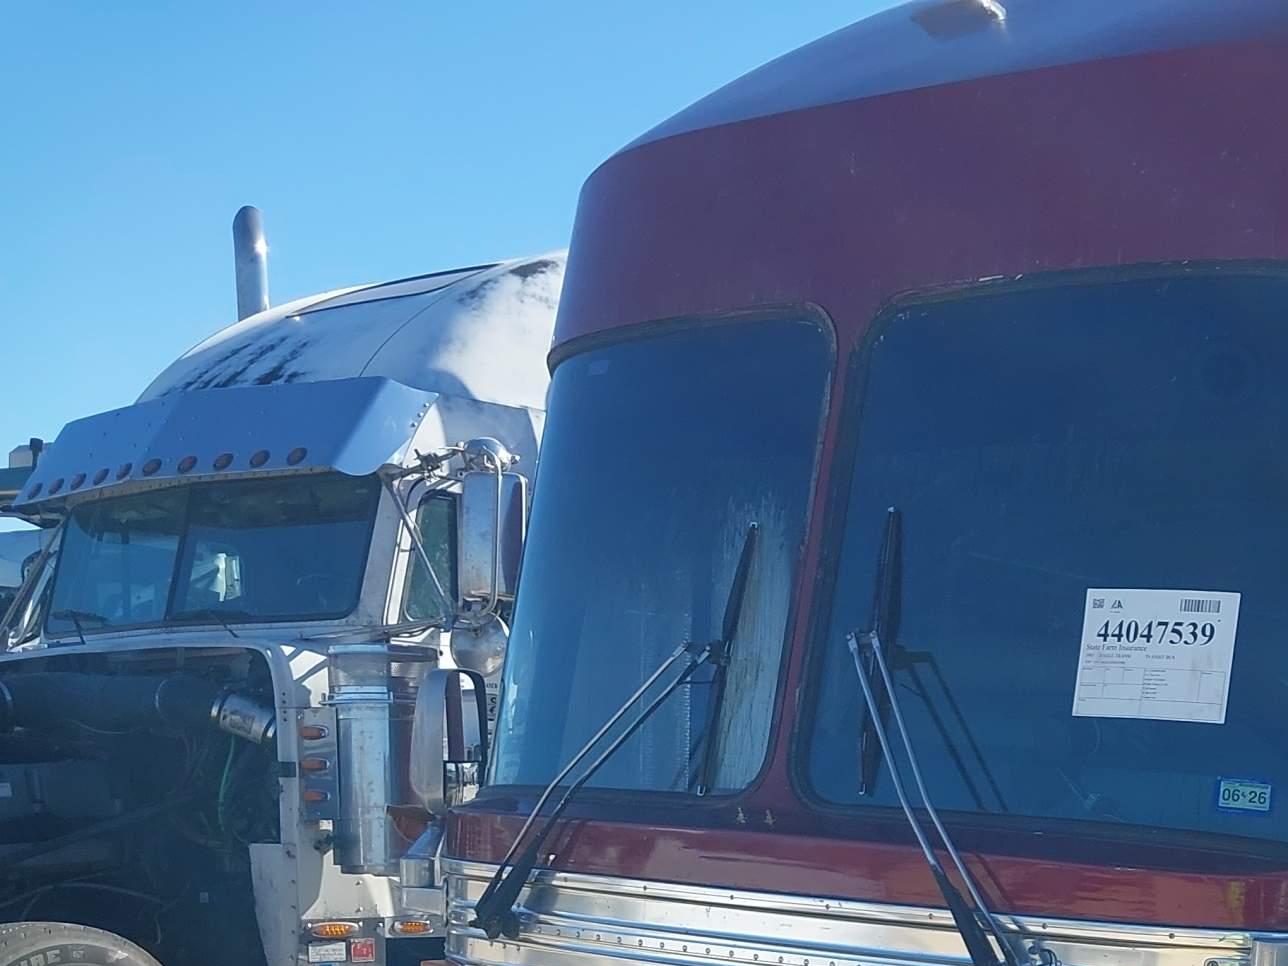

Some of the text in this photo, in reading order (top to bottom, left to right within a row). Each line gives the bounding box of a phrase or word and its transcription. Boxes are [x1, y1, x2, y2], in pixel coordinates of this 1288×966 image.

[1096, 619, 1216, 646] 44047539
[1086, 643, 1102, 651] State
[1222, 787, 1267, 805] 06 26
